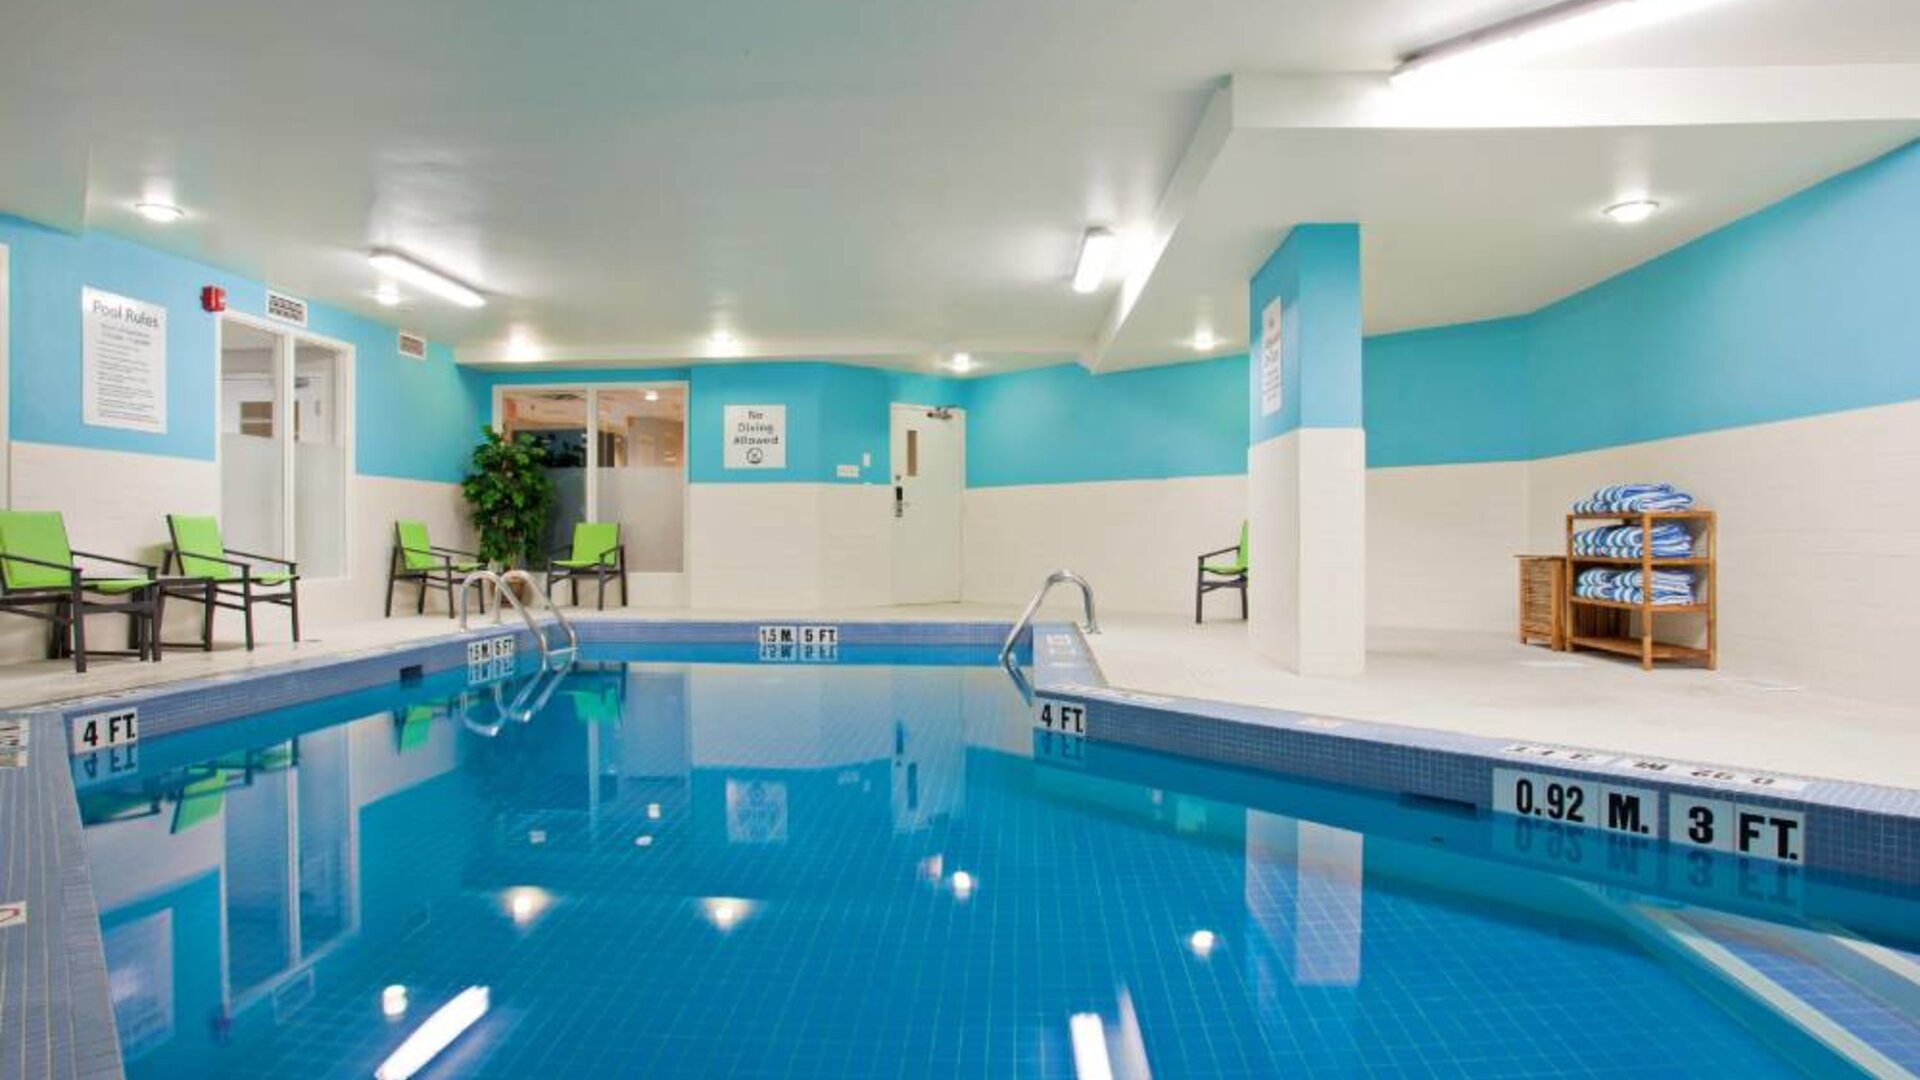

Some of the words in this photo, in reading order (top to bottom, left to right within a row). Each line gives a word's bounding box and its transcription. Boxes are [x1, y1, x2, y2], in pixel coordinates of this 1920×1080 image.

[92, 299, 122, 319] Pool
[125, 308, 159, 328] Rules
[805, 628, 814, 643] 5
[83, 720, 98, 746] 4
[109, 713, 136, 743] FT.
[1041, 703, 1053, 728] 4
[1516, 779, 1585, 823] 0.92
[1608, 793, 1649, 834] M.
[1688, 806, 1714, 844] 3
[1738, 812, 1798, 860] FT.
